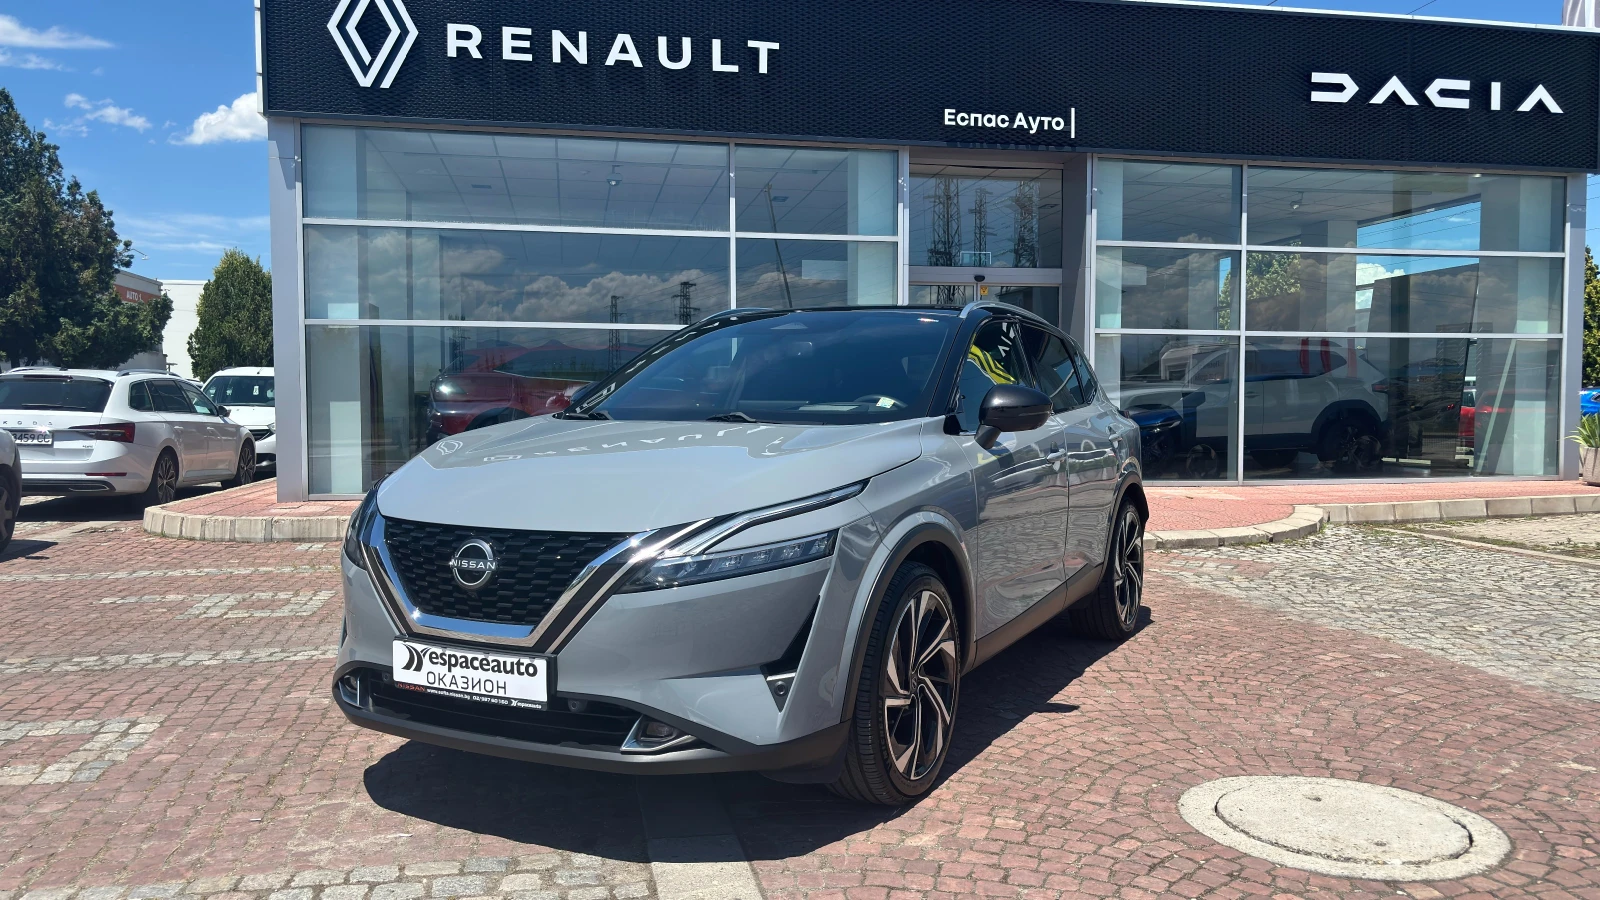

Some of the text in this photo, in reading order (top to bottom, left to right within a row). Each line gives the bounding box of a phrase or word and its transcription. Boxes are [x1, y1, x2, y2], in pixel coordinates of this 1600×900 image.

[446, 22, 780, 74] RENAULT
[1310, 71, 1564, 114] DACIA
[944, 108, 1065, 134] Еспас Ауто
[449, 559, 496, 570] NISSAN
[428, 650, 538, 677] espaceauto
[398, 683, 425, 692] NISSAN
[426, 671, 507, 695] ОКАЗИОН
